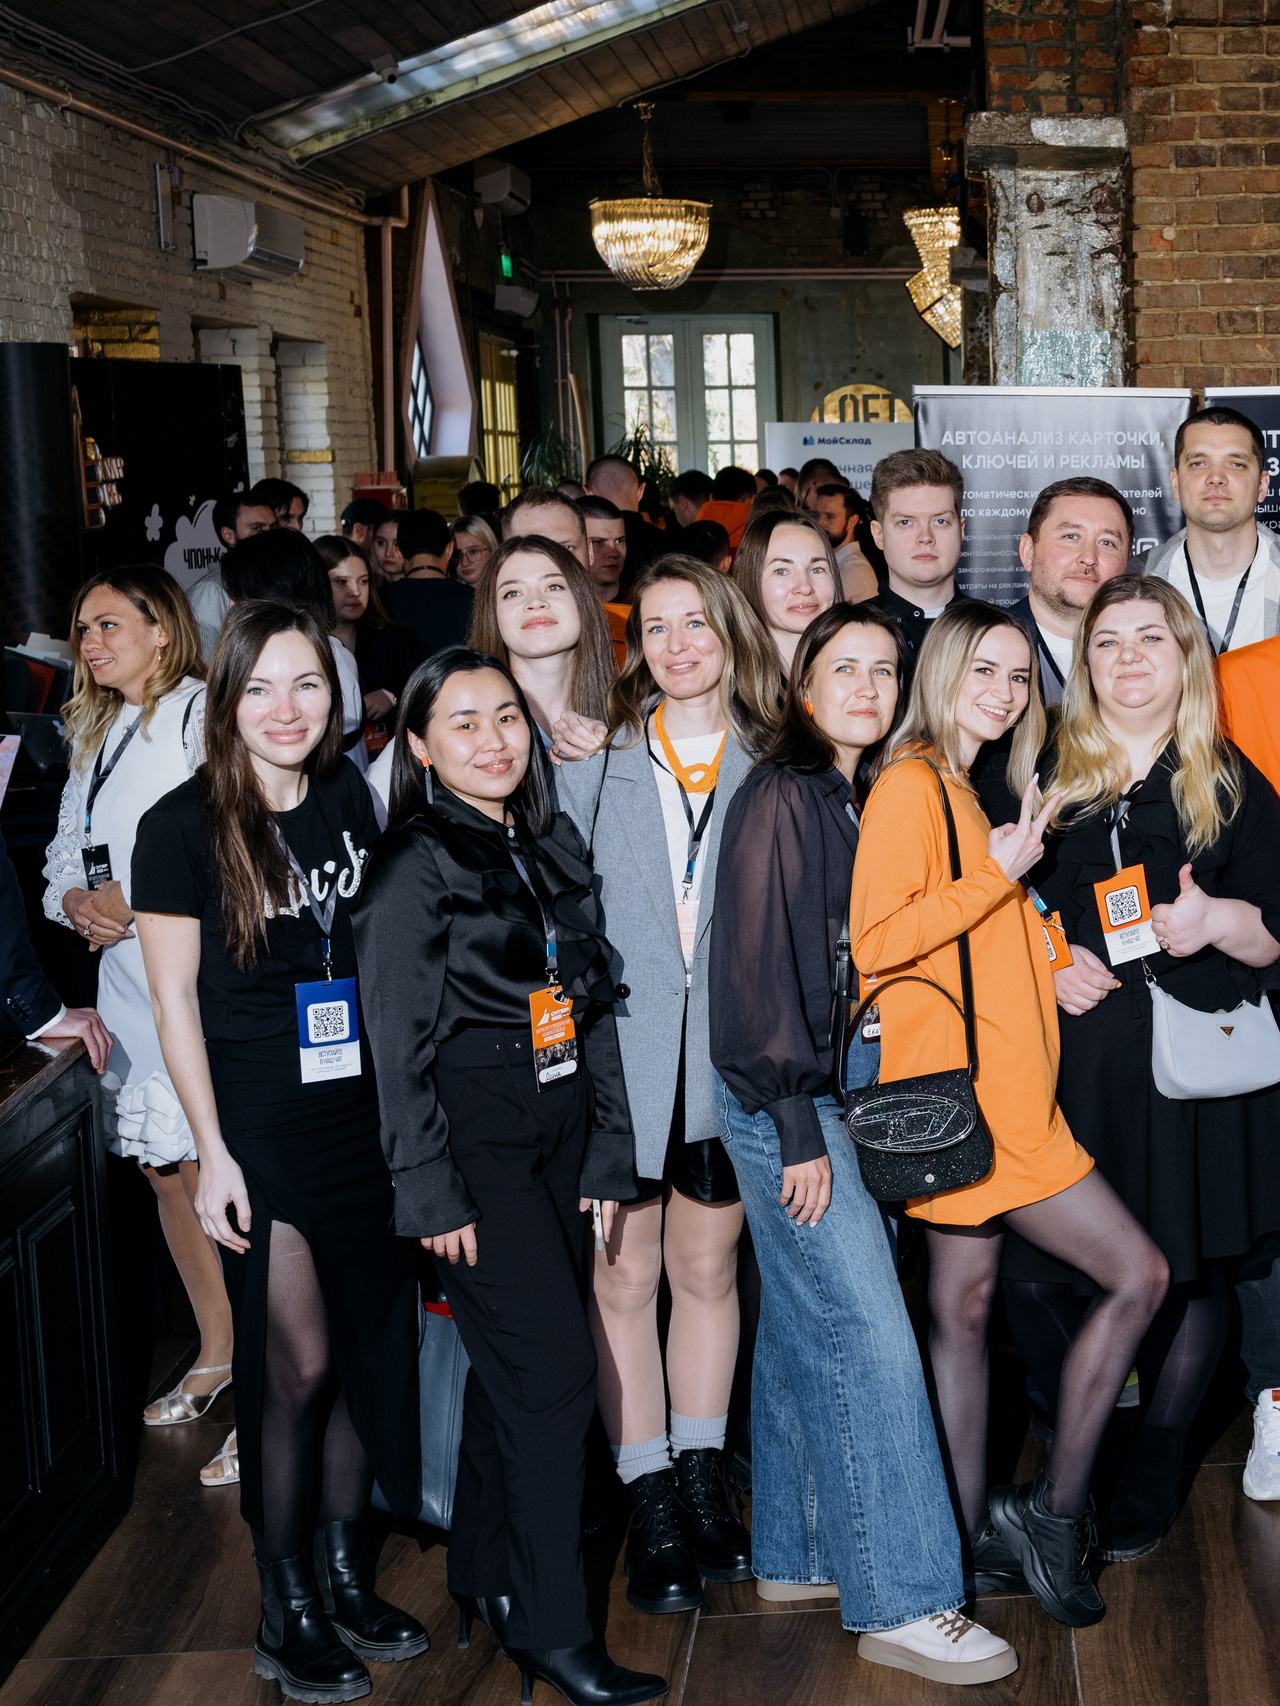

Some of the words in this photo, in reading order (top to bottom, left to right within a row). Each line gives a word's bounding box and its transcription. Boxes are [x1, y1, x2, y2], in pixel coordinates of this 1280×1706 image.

[817, 436, 872, 446] МойСклад
[941, 431, 1064, 446] АВТОАНАЛИЗ
[1069, 431, 1165, 449] КАРТОЧКИ,
[962, 450, 1039, 470] КЛЮЧЕЙ
[1043, 455, 1055, 469] И
[1060, 455, 1145, 469] РЕКЛАМЫ
[838, 464, 873, 474] чная
[963, 488, 1044, 500] томатически
[960, 508, 976, 517] по
[978, 508, 1032, 519] каждому
[963, 532, 1011, 542] аржинальная
